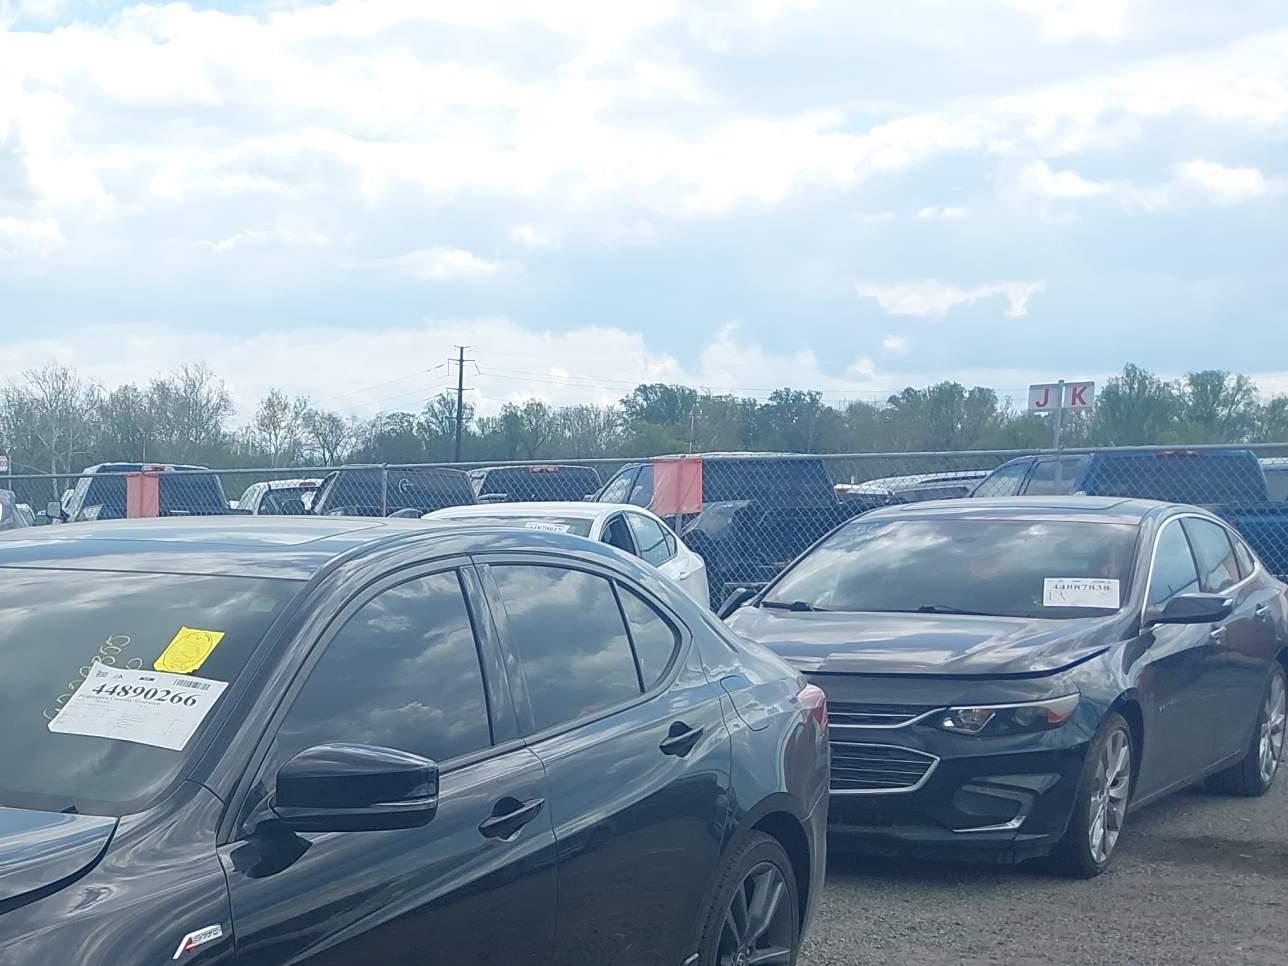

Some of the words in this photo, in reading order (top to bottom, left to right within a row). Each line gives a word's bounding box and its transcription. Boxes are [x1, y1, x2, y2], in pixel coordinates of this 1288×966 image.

[1035, 388, 1049, 407] J
[1071, 386, 1087, 405] K
[91, 682, 202, 708] 44890266
